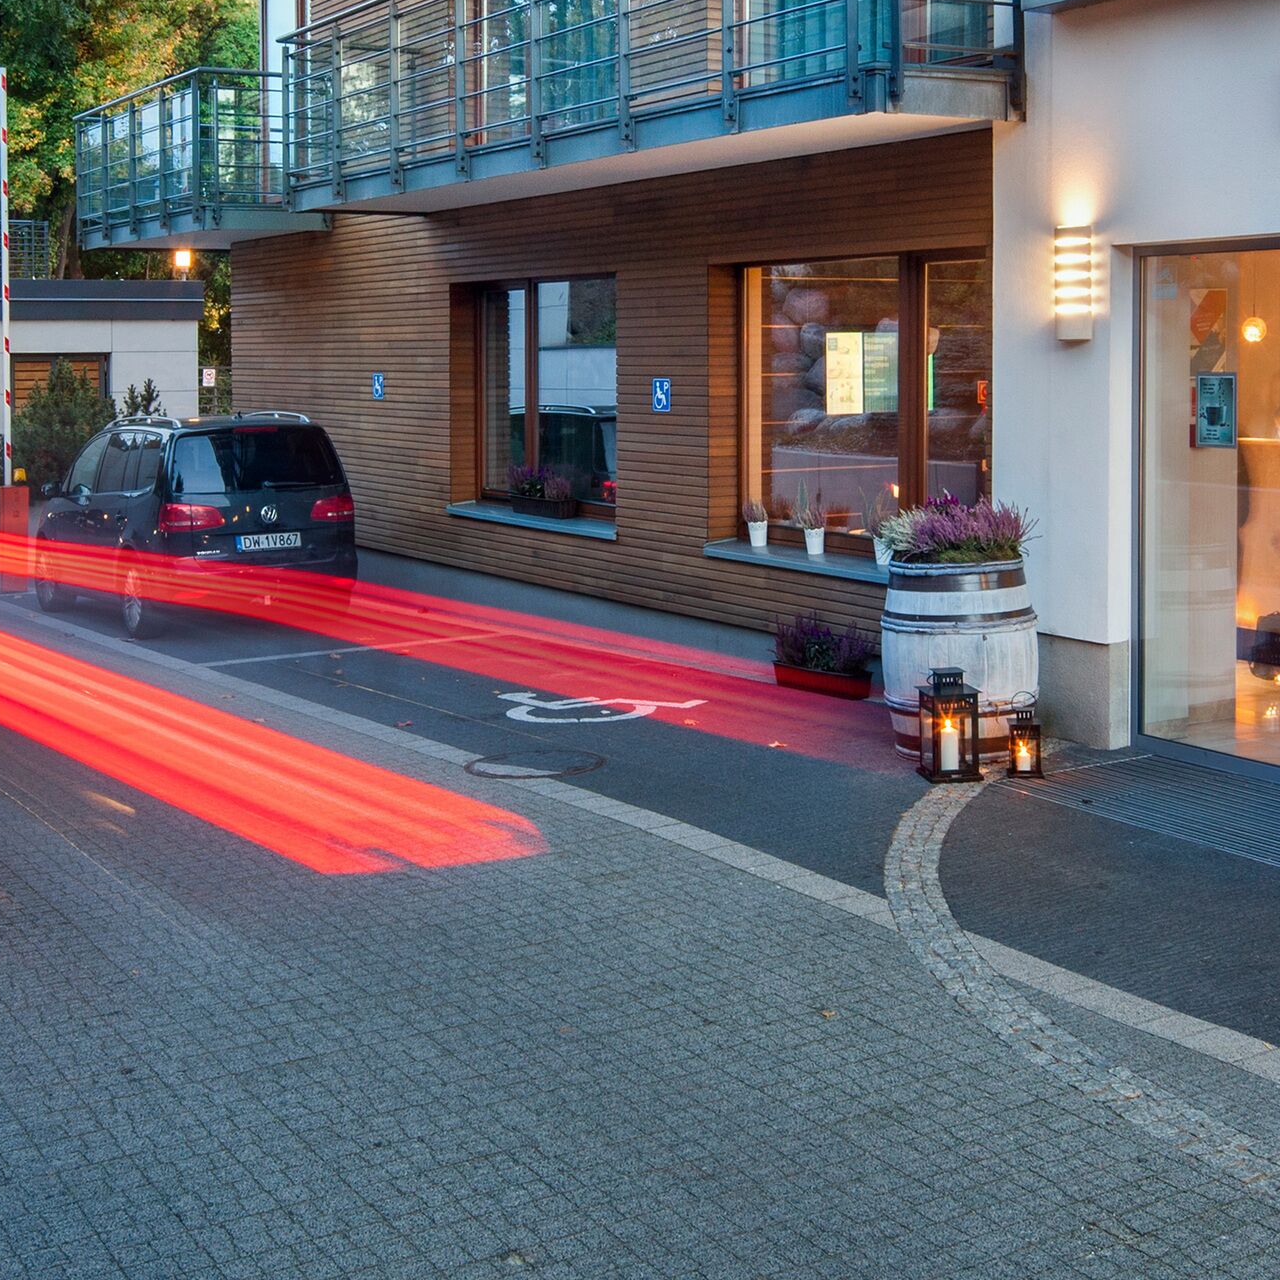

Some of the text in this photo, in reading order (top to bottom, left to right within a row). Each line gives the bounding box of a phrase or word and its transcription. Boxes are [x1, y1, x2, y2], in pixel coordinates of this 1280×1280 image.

[663, 382, 669, 393] P
[243, 533, 299, 549] DW 1V867
